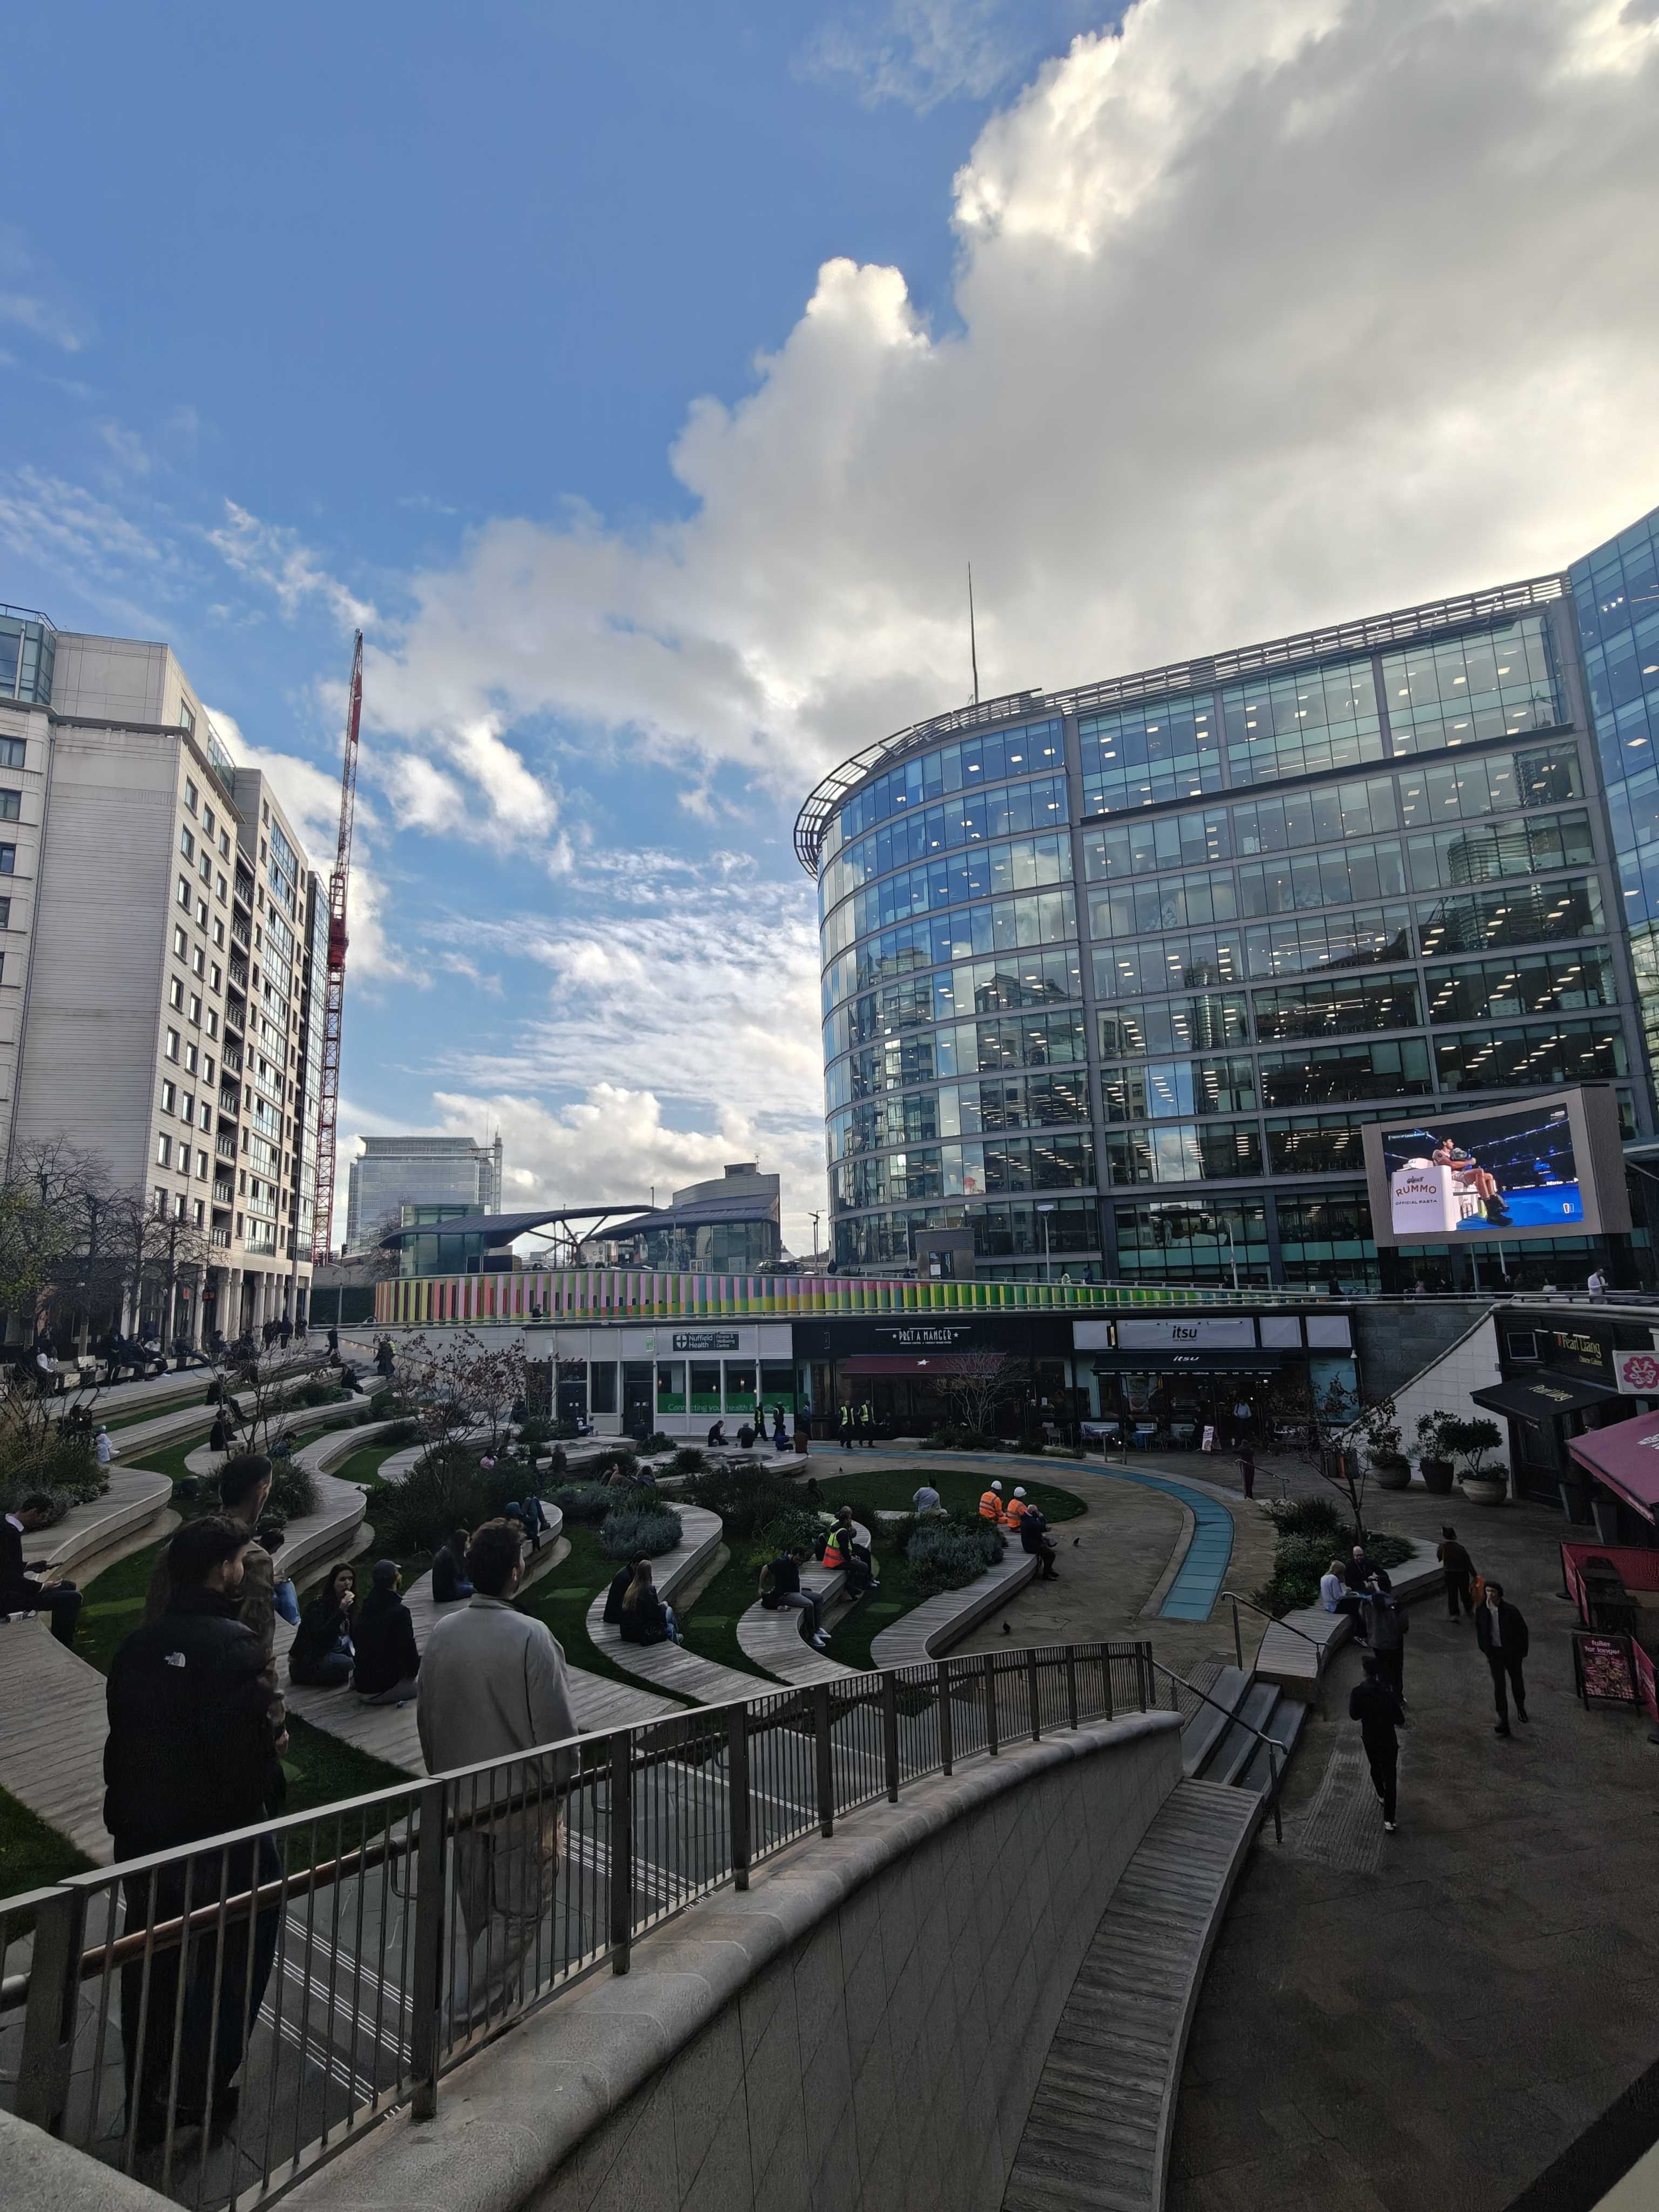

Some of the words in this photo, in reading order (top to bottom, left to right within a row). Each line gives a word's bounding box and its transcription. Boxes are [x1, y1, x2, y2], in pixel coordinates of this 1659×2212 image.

[1395, 1184, 1437, 1197] RUMMO
[899, 1330, 914, 1341] PRET
[916, 1330, 921, 1340] A
[923, 1329, 952, 1340] MANGER
[1172, 1325, 1197, 1338] itsu
[1562, 1335, 1580, 1351] Pearl
[1580, 1338, 1602, 1359] Liang
